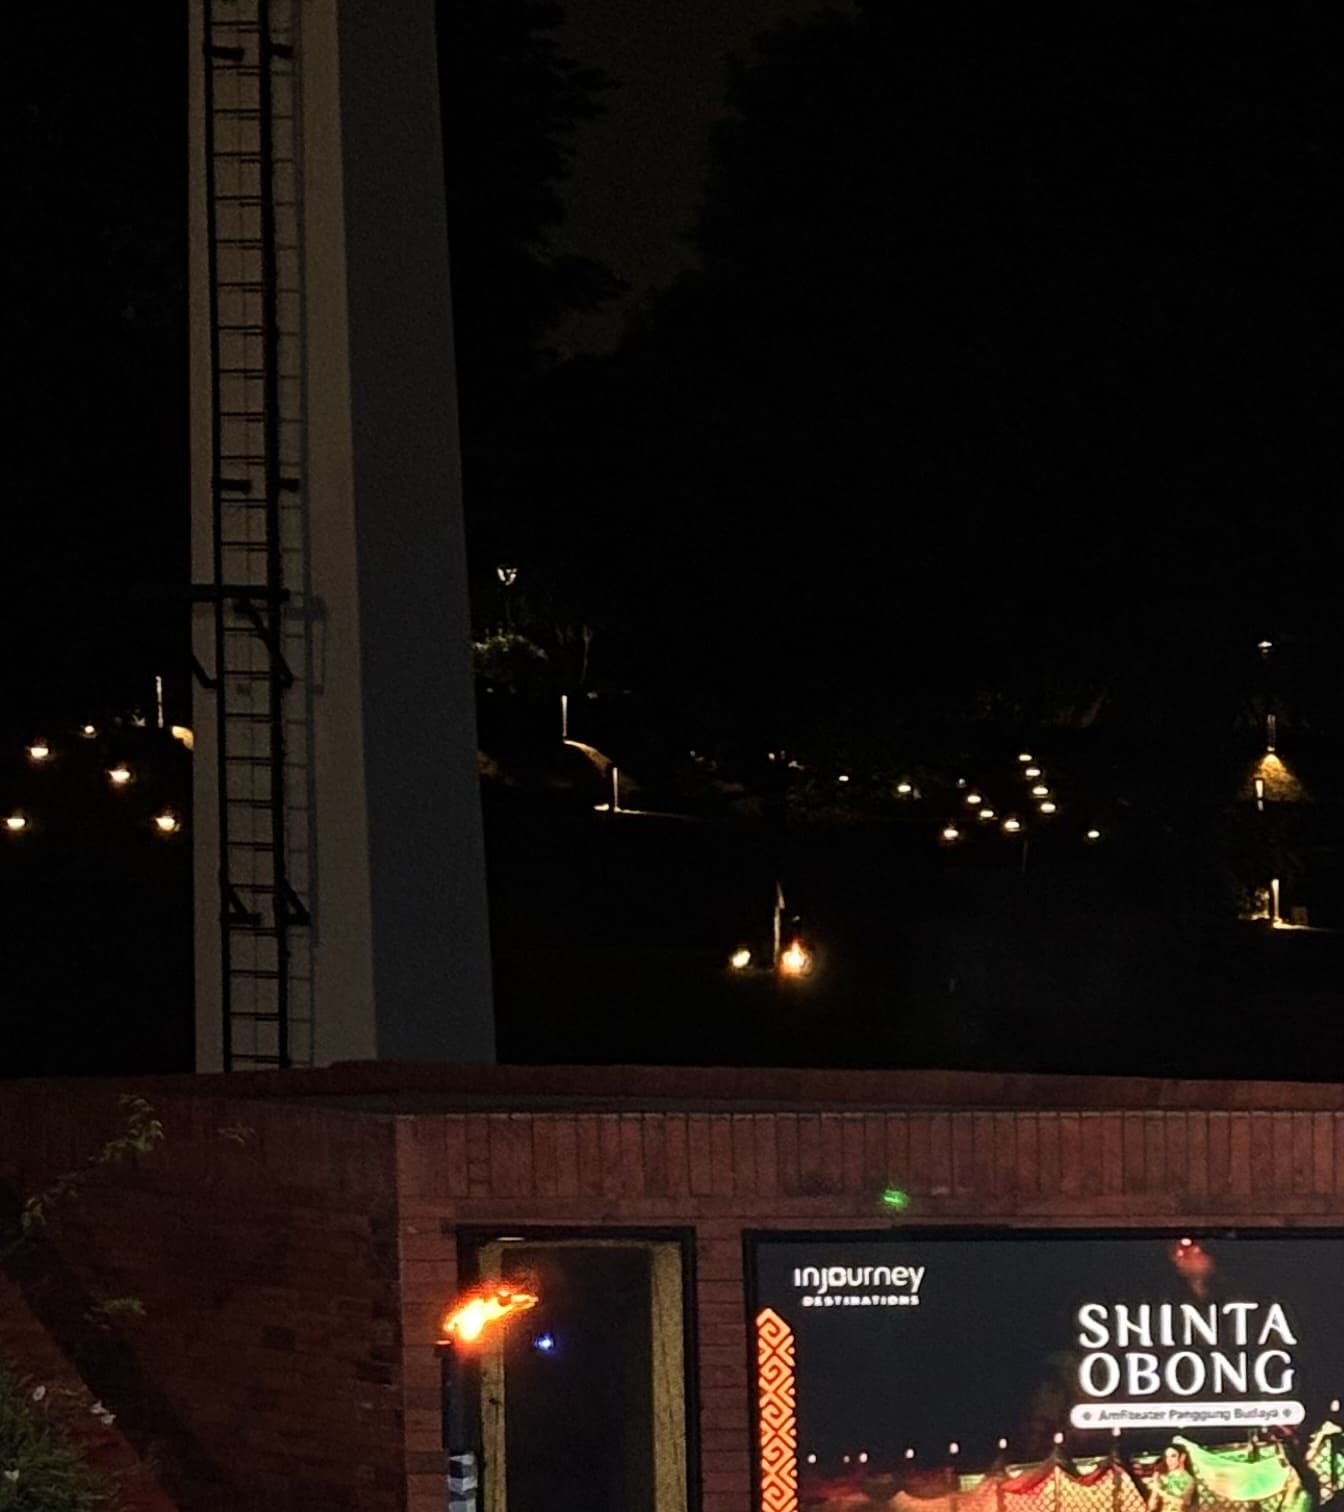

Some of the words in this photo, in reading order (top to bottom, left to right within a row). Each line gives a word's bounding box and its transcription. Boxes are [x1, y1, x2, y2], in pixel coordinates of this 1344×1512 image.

[802, 1295, 919, 1306] DESTINATIONS
[1078, 1303, 1297, 1348] SHINTA
[1079, 1350, 1296, 1397] OBONG
